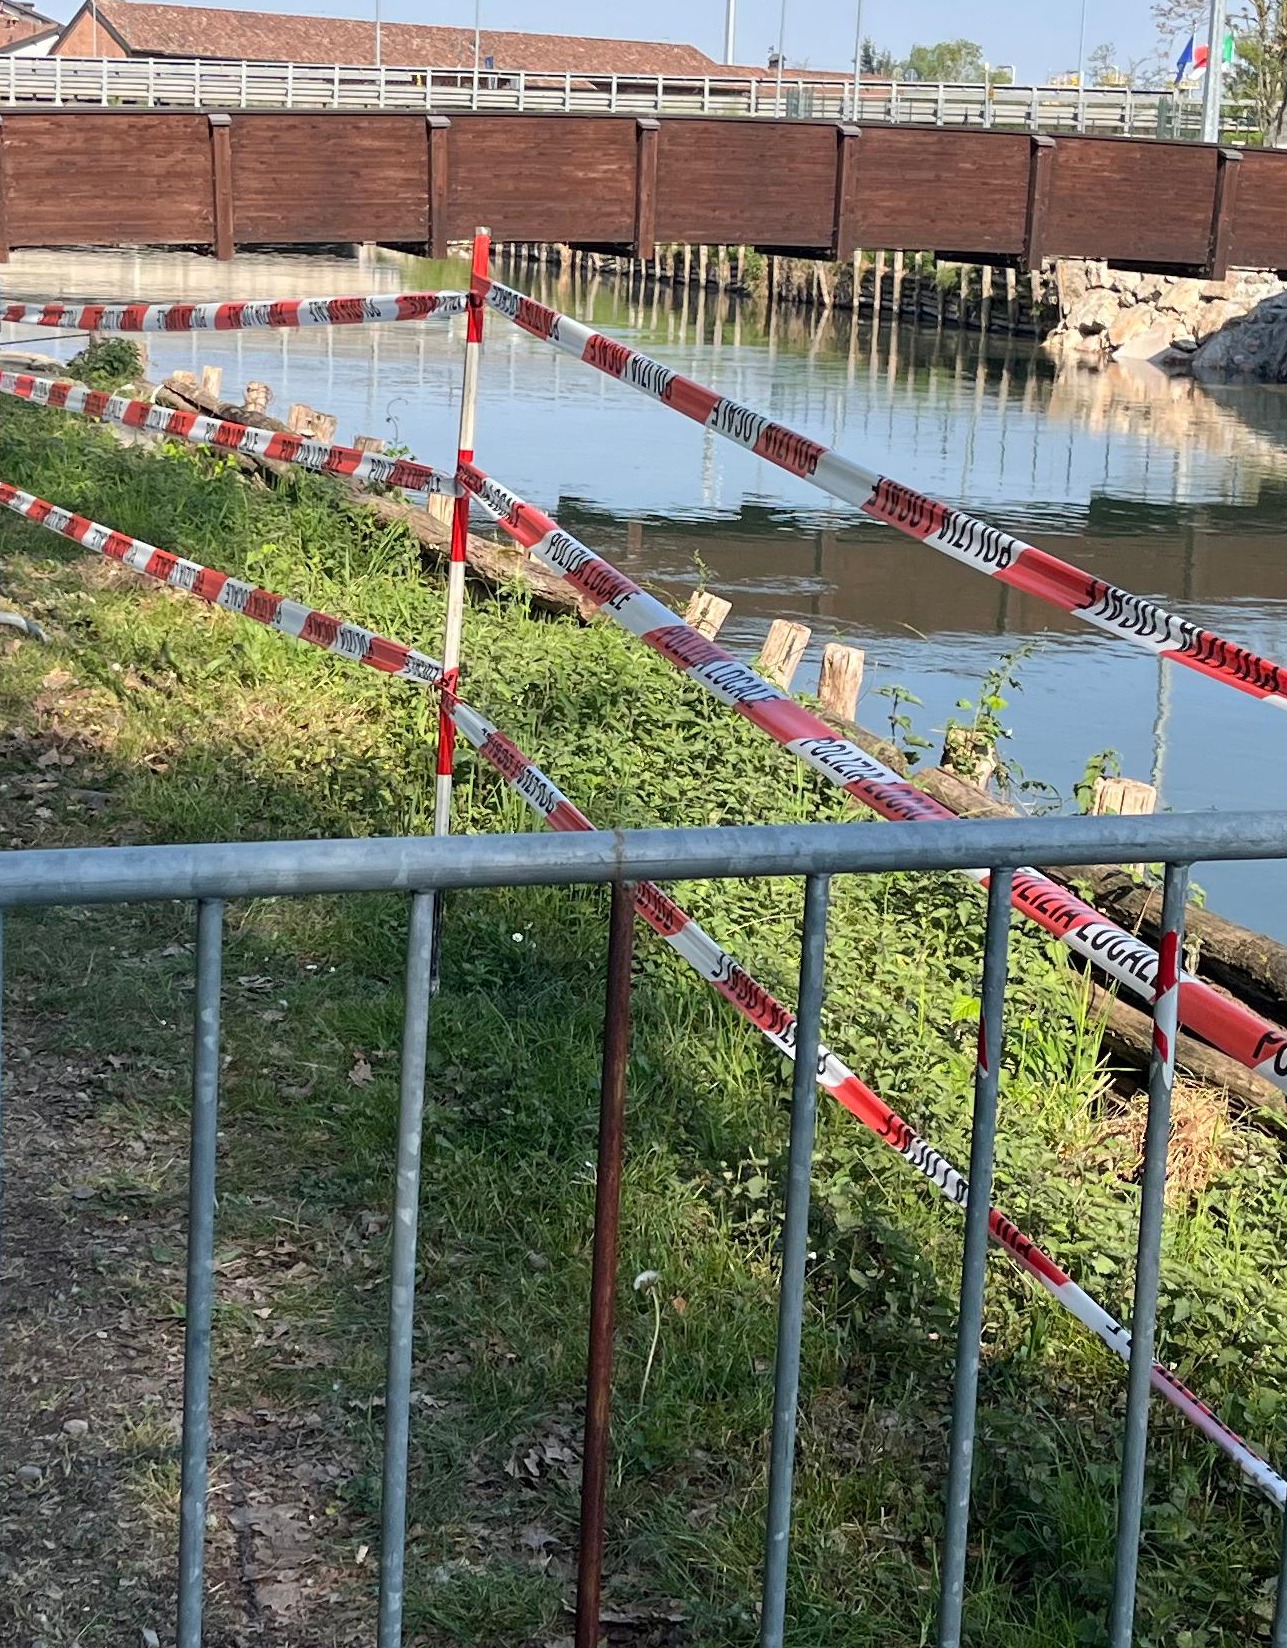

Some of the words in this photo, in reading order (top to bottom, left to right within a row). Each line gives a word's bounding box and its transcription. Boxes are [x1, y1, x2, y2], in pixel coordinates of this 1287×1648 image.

[712, 397, 766, 443] LOCALE
[765, 421, 824, 476] POLIZIA
[867, 474, 938, 534] LOCALE
[937, 507, 1016, 570] POLIZIA
[545, 532, 596, 582] POLIZIA
[584, 561, 640, 611] LOCALE
[655, 625, 716, 672] POLIZIA
[704, 660, 780, 709] LOCALE
[800, 736, 885, 785] POLIZIA
